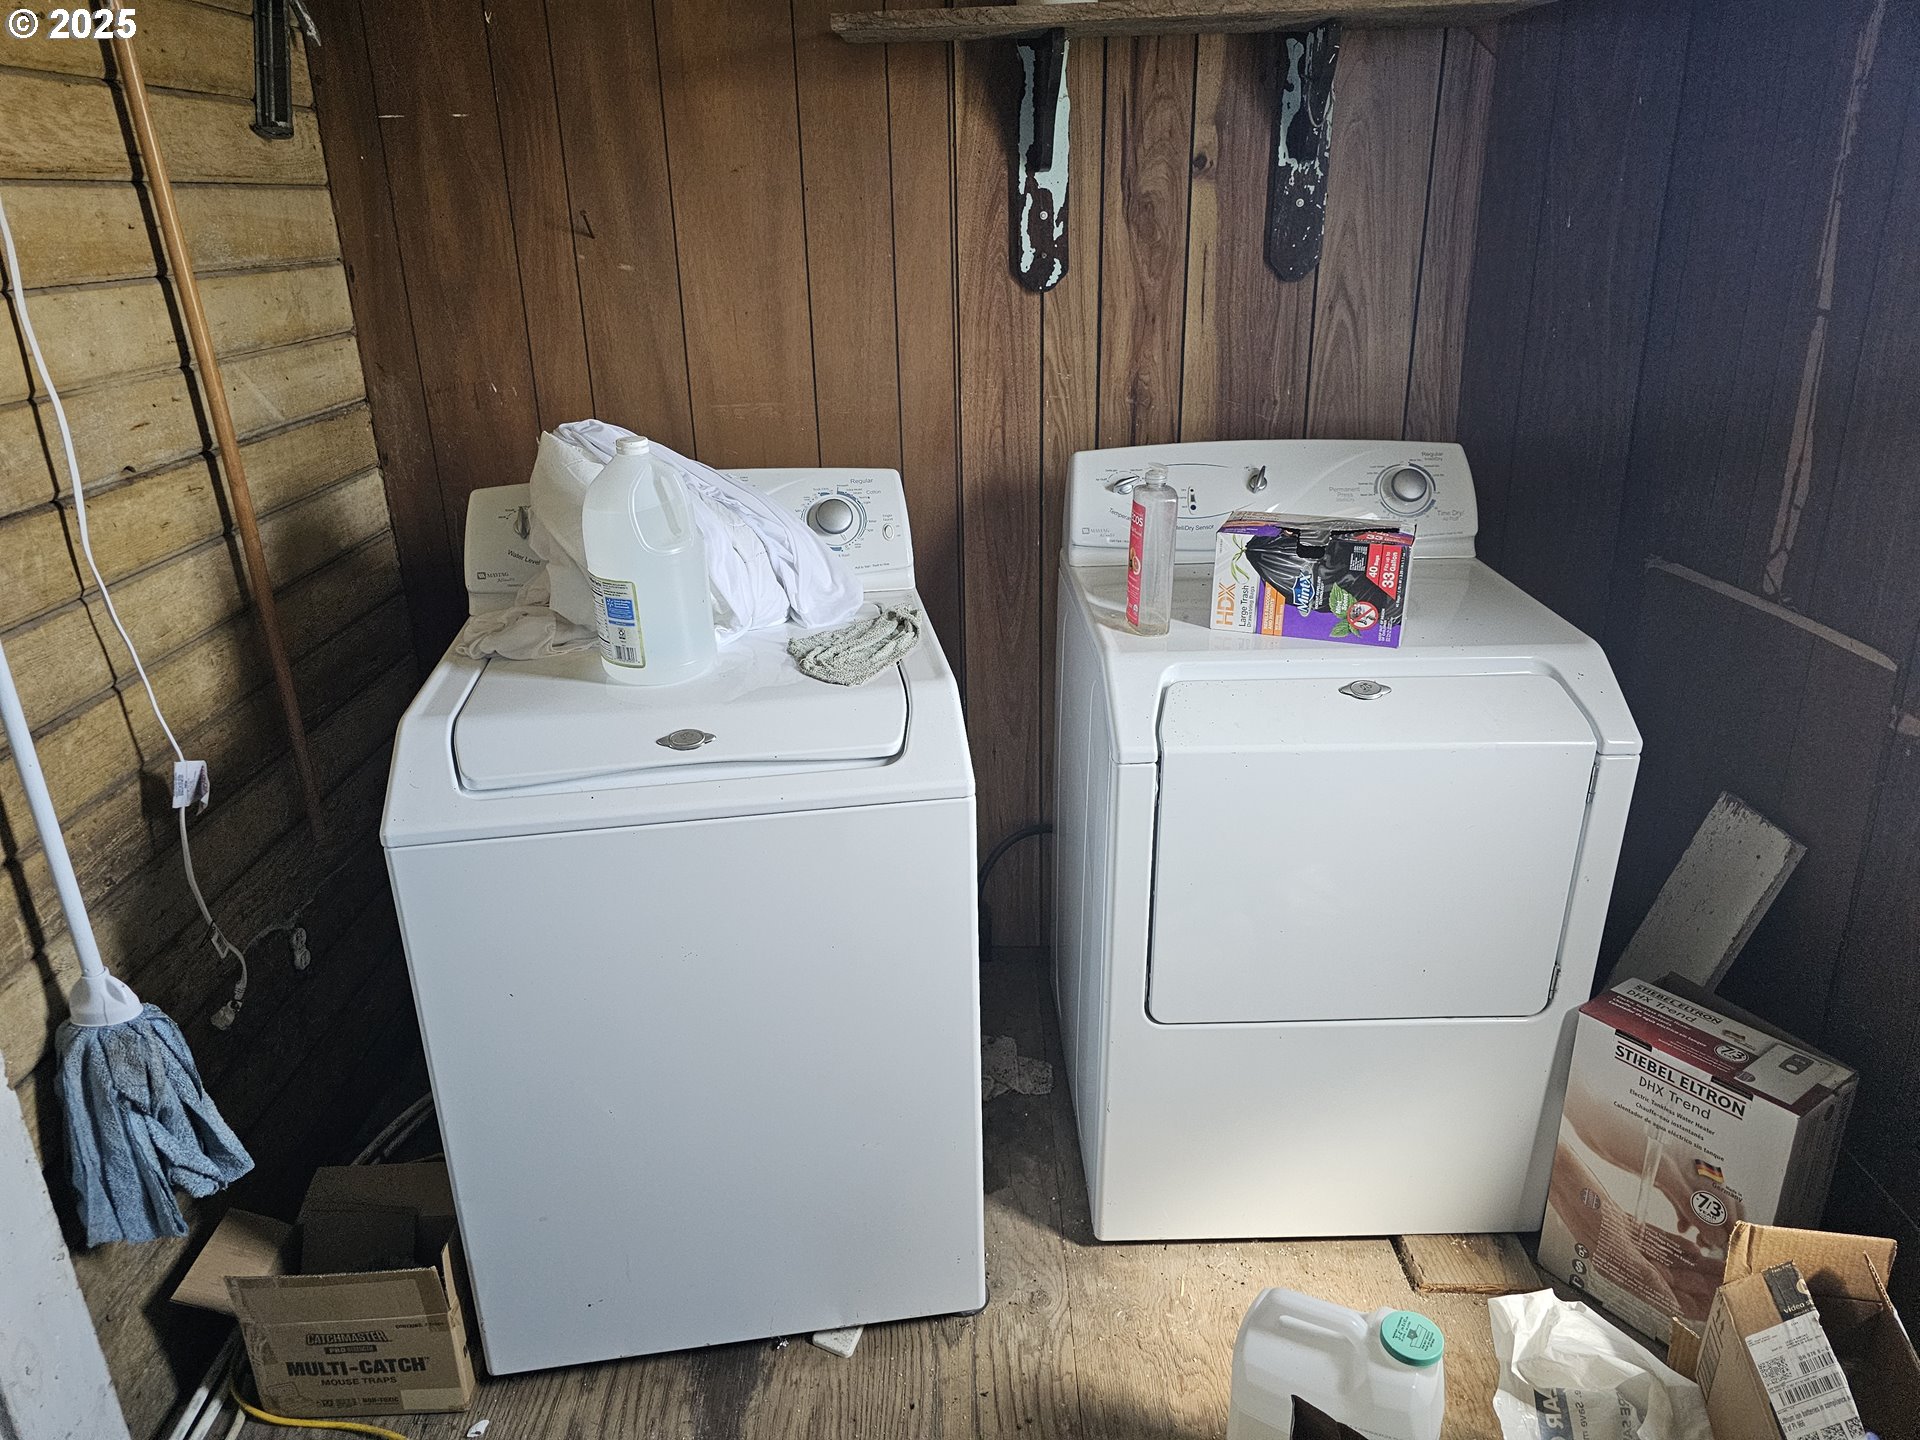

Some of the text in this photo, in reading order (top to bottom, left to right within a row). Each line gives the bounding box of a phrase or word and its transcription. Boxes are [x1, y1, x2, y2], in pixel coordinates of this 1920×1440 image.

[508, 549, 541, 566] Water Level
[1390, 552, 1398, 572] Gallon
[1368, 566, 1378, 578] 40
[1382, 572, 1395, 589] 33
[1297, 570, 1312, 613] MintX
[1216, 582, 1236, 626] HDX
[1239, 585, 1249, 627] Large Trash
[1626, 990, 1697, 1023] DHX Trend
[1615, 1044, 1676, 1084] STIEBEL
[1680, 1076, 1746, 1118] ELTRON
[1639, 1076, 1711, 1120] DHX Trend
[1630, 1088, 1716, 1136] Electric Tankless Water Heater
[1636, 1102, 1670, 1123] Chauffe-eau
[1614, 1100, 1725, 1163] Calentador de agua eléctrico sin tanque
[1712, 1182, 1743, 1203] Germany
[1699, 1208, 1717, 1221] YEAR
[1783, 1302, 1806, 1314] video
[306, 1330, 388, 1346] CATCHMASTER
[321, 1376, 397, 1386] MOUSE TRAPS
